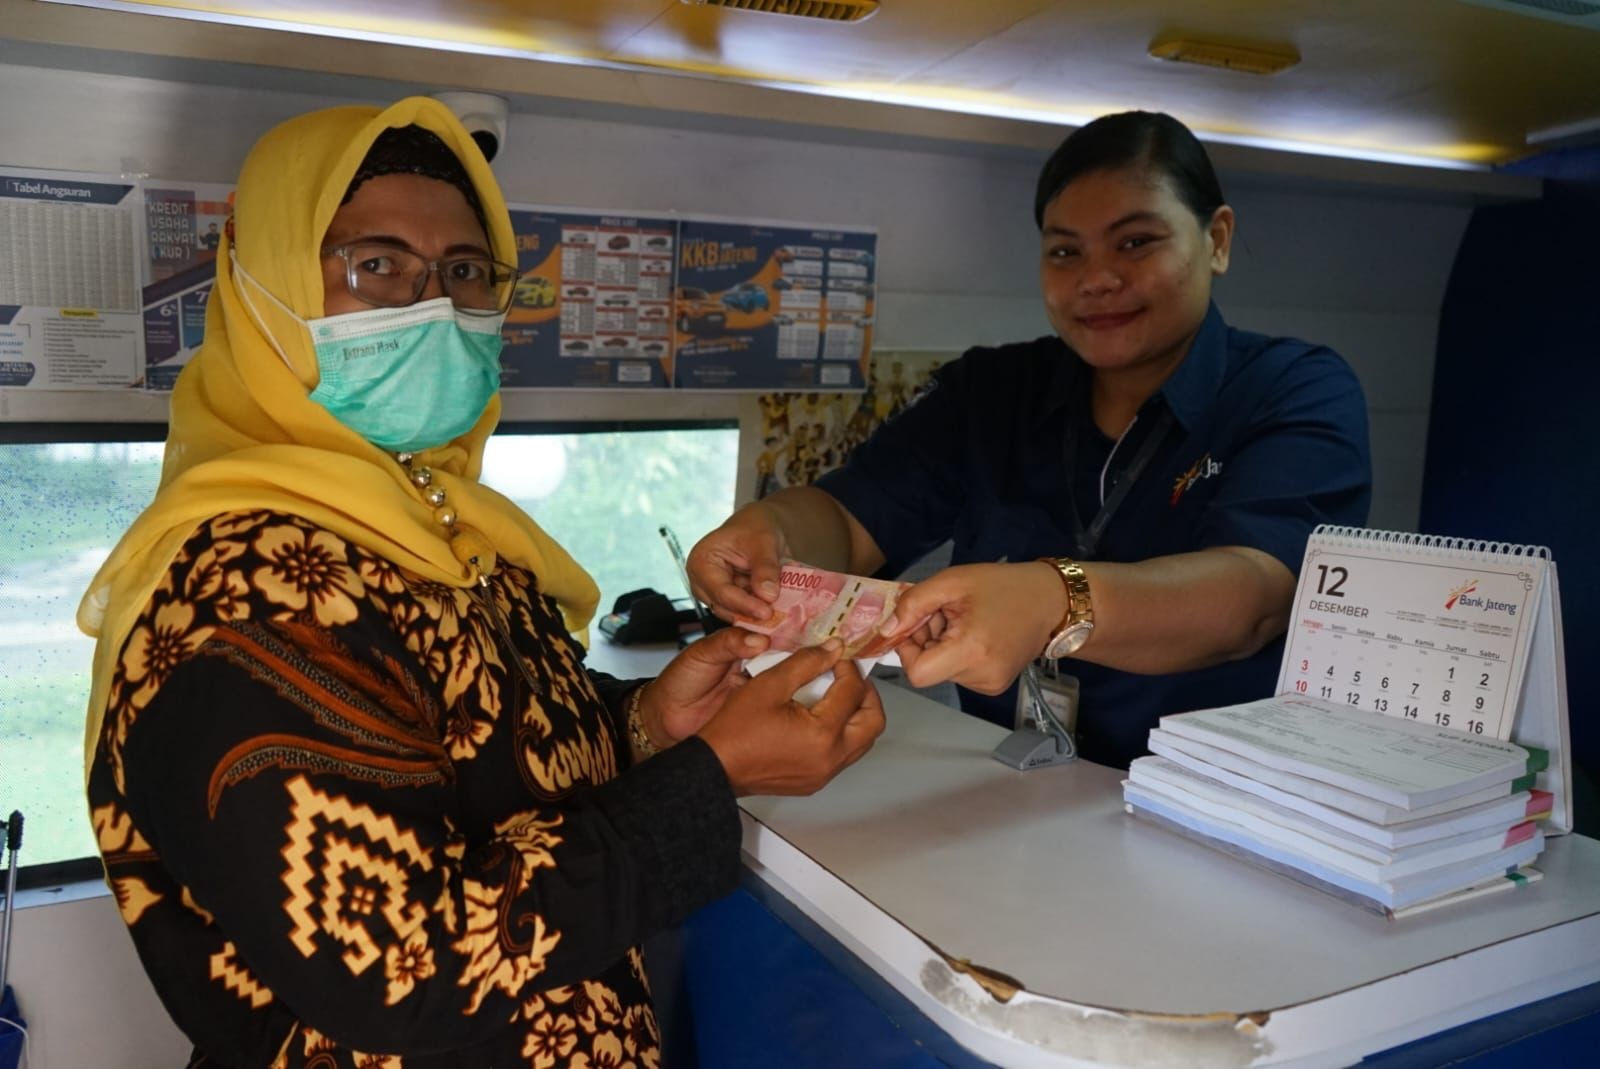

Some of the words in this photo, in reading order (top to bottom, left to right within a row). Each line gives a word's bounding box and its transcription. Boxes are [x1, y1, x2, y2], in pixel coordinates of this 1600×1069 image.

[12, 182, 42, 194] Tabel
[42, 183, 92, 198] Angsuran
[150, 202, 189, 215] KREDIT
[150, 216, 189, 229] USAHA
[151, 231, 195, 244] RAKYAT
[682, 240, 720, 268] KKB
[1316, 564, 1348, 597] 12
[1309, 600, 1369, 618] DESEMBER
[1459, 595, 1483, 608] Bank
[1483, 598, 1517, 616] Jateng
[1415, 639, 1434, 648] Kamis
[1446, 644, 1467, 654] Jumat
[1480, 650, 1500, 660] Sabtu
[1301, 660, 1308, 671] 3
[1326, 665, 1334, 676] 4
[1353, 671, 1361, 682] 5
[1381, 677, 1389, 688] 6
[1411, 683, 1419, 694] 7
[1442, 690, 1451, 702] 8
[1475, 696, 1484, 709] 9
[1448, 667, 1455, 679] 1
[1480, 674, 1489, 686] 2
[1295, 680, 1308, 693] 10
[1321, 686, 1332, 698] 11
[1347, 692, 1360, 705] 12
[1374, 698, 1388, 712] 13
[1403, 705, 1418, 719] 14
[1434, 712, 1450, 726] 15
[1467, 720, 1484, 734] 16
